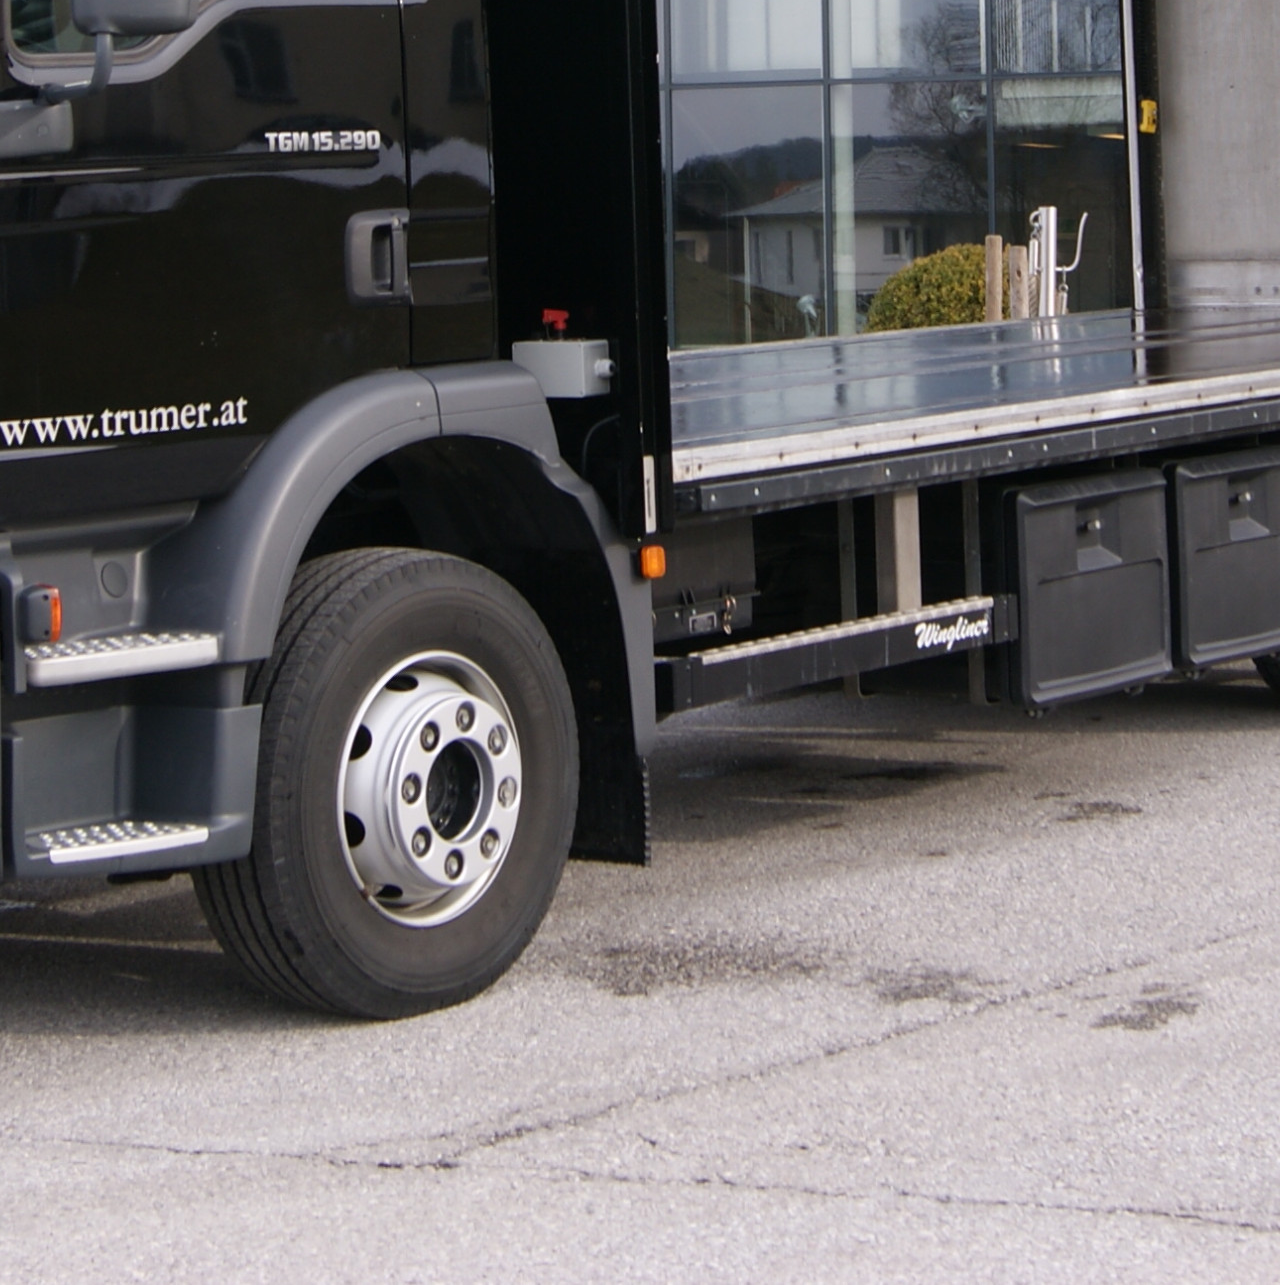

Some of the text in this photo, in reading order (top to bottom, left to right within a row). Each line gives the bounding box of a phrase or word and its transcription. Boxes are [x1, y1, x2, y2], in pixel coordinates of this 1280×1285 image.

[264, 129, 381, 152] TGM 15.290
[915, 616, 989, 651] Wingliner
